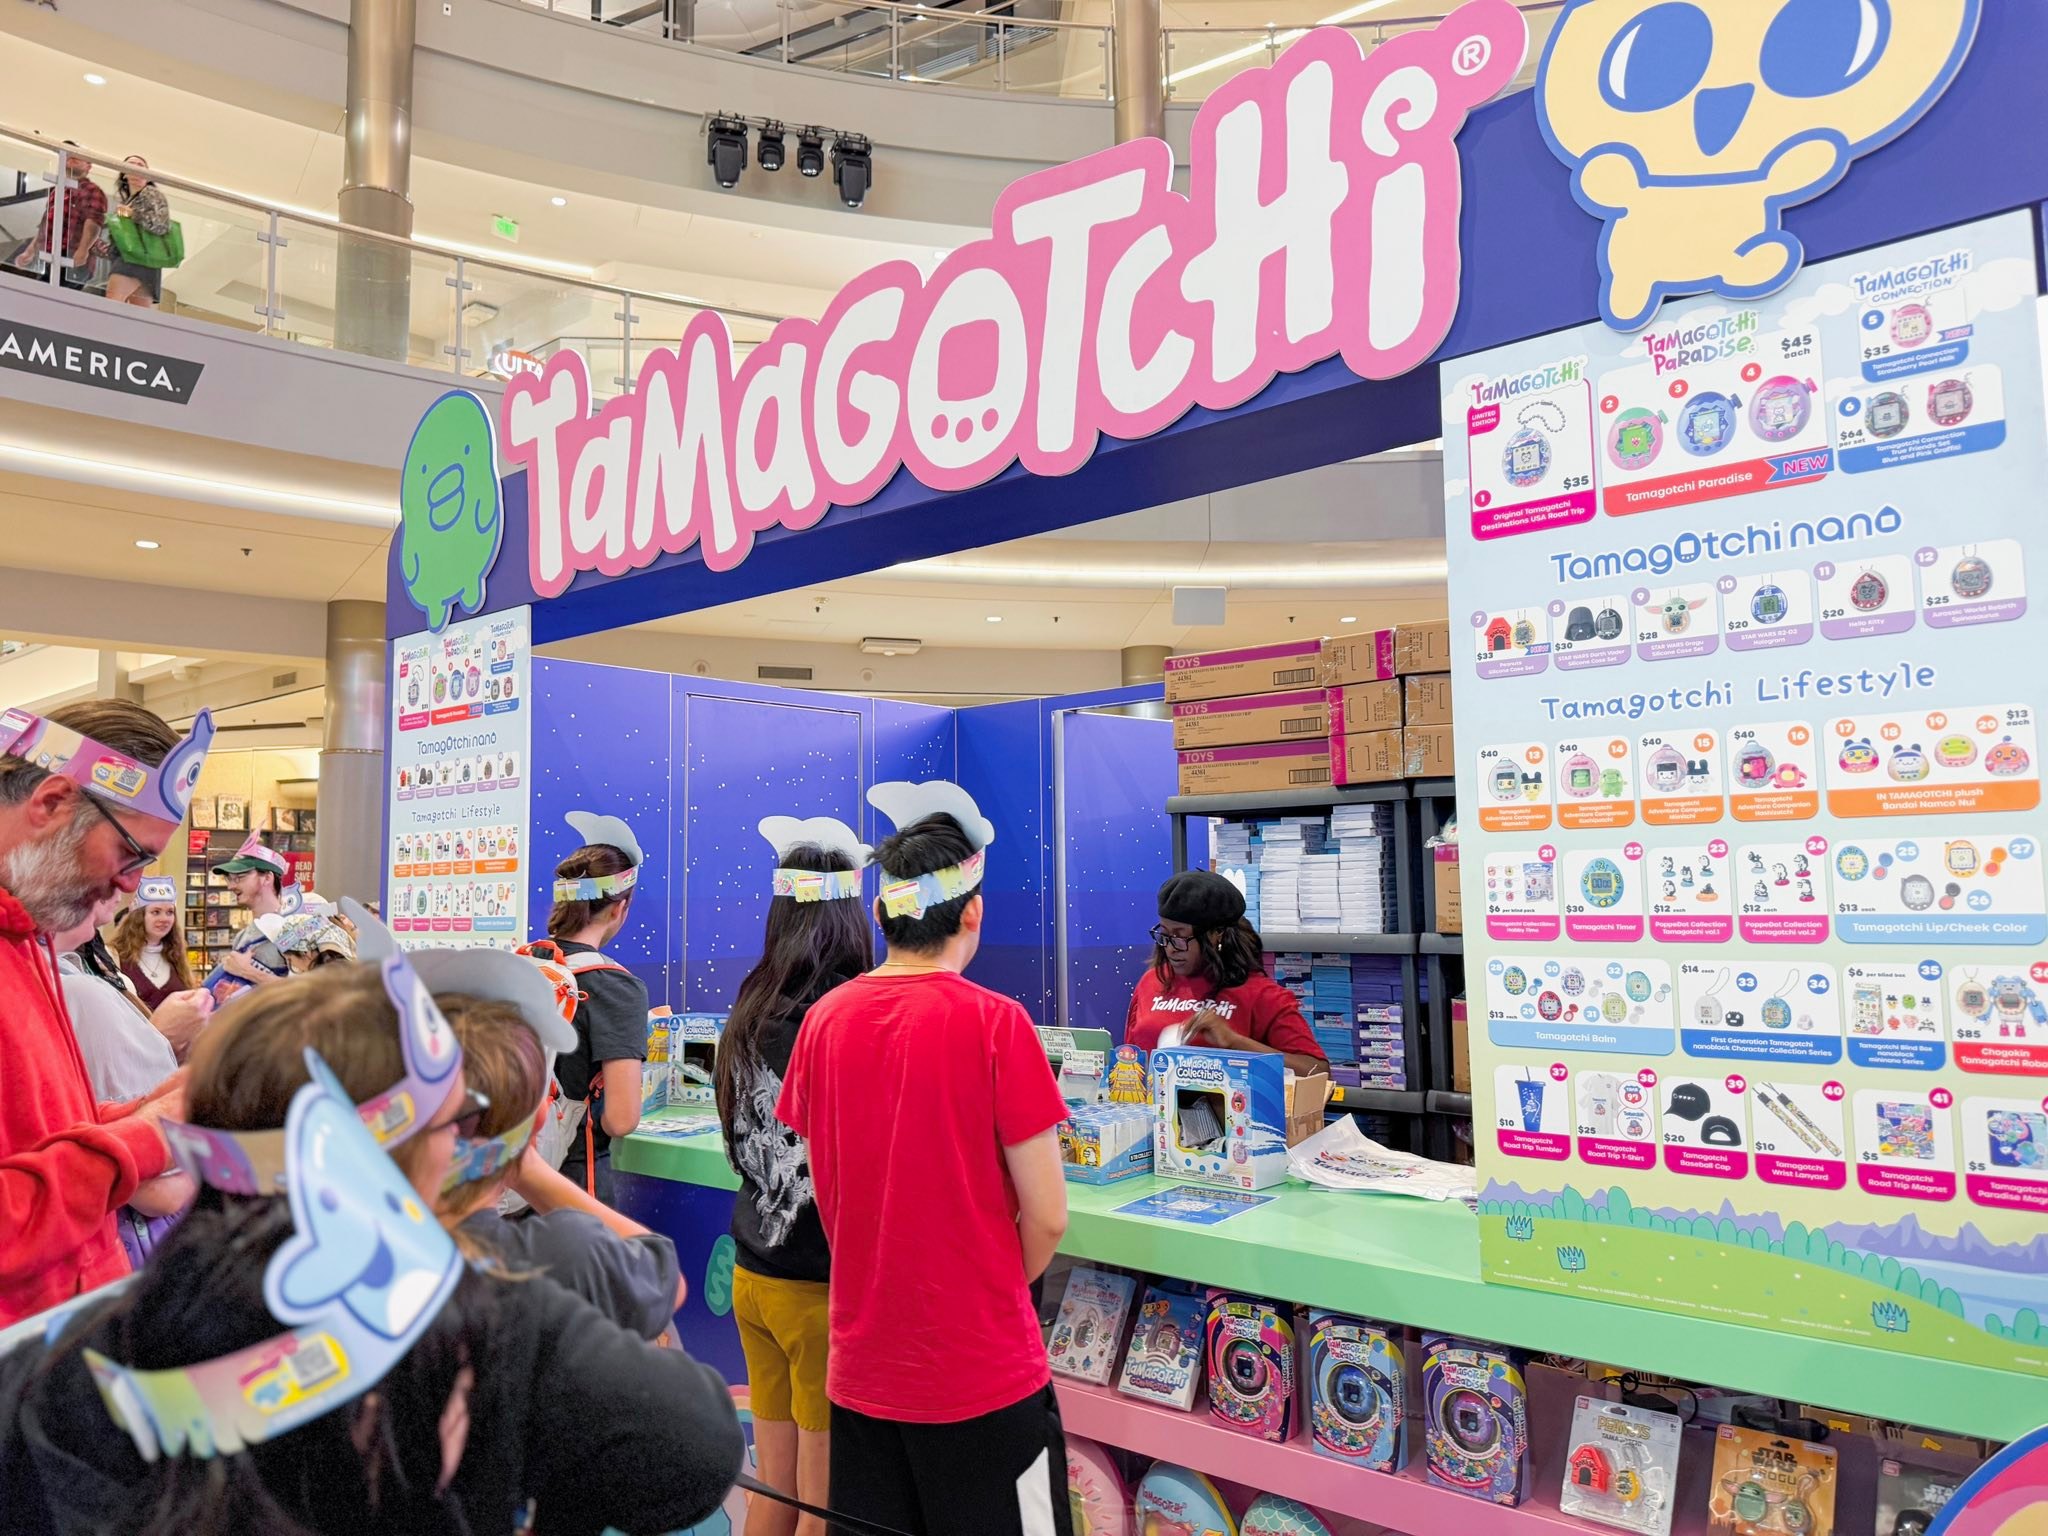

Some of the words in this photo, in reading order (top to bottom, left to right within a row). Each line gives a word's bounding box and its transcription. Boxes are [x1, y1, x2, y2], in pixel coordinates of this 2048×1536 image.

[1872, 276, 1952, 303] CONNECTION
[1868, 316, 1877, 325] 5
[1781, 334, 1812, 352] $45
[1784, 347, 1810, 359] each
[1864, 345, 1890, 359] $35
[1876, 362, 1918, 376] Strawberry
[1918, 358, 1938, 368] Pearl
[1939, 354, 1955, 364] Milk
[1747, 368, 1755, 376] 4
[1674, 385, 1682, 393] 3
[1606, 400, 1613, 408] 2
[1845, 402, 1854, 410] 6
[1472, 410, 1496, 420] LIMITED
[1472, 418, 1496, 427] EDITION
[1840, 429, 1863, 441] $64
[1783, 455, 1828, 475] NEW
[1563, 475, 1589, 489] $35
[1626, 482, 1695, 502] Tamagotchi
[1698, 471, 1752, 490] Paradise
[1480, 494, 1485, 502] 1
[1493, 510, 1523, 520] Original
[1525, 501, 1571, 516] Tamagotchi
[1550, 521, 1782, 582] Tamagotchi
[1790, 505, 1902, 547] nano
[1918, 552, 1934, 563] 12
[1819, 567, 1830, 576] 11
[1720, 579, 1734, 589] 10
[1636, 591, 1644, 600] 9
[1926, 596, 1949, 606] $25
[1552, 604, 1561, 612] 8
[1822, 609, 1844, 619] $20
[1475, 615, 1482, 624] 7
[1728, 620, 1748, 630] $20
[1639, 632, 1658, 641] $28
[1555, 642, 1573, 651] $30
[1477, 652, 1494, 661] $33
[1171, 657, 1200, 669] TOYS
[1541, 680, 1732, 719] Tamagotchi
[1758, 662, 1935, 701] Lifestyle
[1179, 704, 1208, 715] TOYS
[2006, 710, 2028, 720] $13
[1928, 716, 1945, 727] 19
[1978, 719, 1996, 730] 20
[1839, 723, 1852, 733] 17
[1883, 727, 1898, 736] 18
[472, 732, 496, 747] nano
[1734, 731, 1755, 740] $40
[1792, 732, 1805, 740] 16
[1642, 738, 1661, 747] $40
[1698, 738, 1710, 747] 15
[1559, 744, 1577, 753] $40
[1611, 745, 1624, 753] 14
[1185, 752, 1214, 762] TOYS
[1481, 750, 1498, 758] $40
[1528, 751, 1540, 759] 13
[1889, 790, 1952, 800] TAMAGOTCHI
[1955, 789, 1984, 798] plush
[1883, 801, 1917, 810] Bandai
[1919, 800, 1955, 808] Namco
[1958, 798, 1976, 806] Nui
[412, 810, 457, 823] Tamagotchi
[462, 803, 501, 818] Lifestyle
[1711, 843, 1726, 853] 23
[1808, 841, 1825, 850] 24
[2012, 843, 2031, 854] 27
[1541, 850, 1553, 858] 21
[1626, 847, 1641, 855] 22
[1898, 846, 1916, 856] 25
[296, 861, 312, 870] READ
[1969, 896, 1989, 905] 26
[1566, 905, 1584, 913] $30
[1853, 923, 1923, 933] Tamagotchi
[1926, 923, 1989, 933] Lip/Cheek
[1992, 923, 2028, 932] Color
[1546, 965, 1558, 973] 30
[1920, 966, 1940, 976] 35
[1738, 978, 1755, 987] 33
[1809, 979, 1827, 989] 34
[1522, 1007, 1534, 1015] 29
[1535, 1032, 1590, 1042] Tamagotchi
[1592, 1034, 1616, 1044] Balm
[1957, 1029, 1981, 1039] $85
[1711, 1036, 1727, 1044] First
[1728, 1037, 1768, 1045] Generation
[1769, 1039, 1813, 1047] Tamagotchi
[1693, 1043, 1730, 1051] nanoblock
[1731, 1045, 1768, 1053] Character
[1769, 1047, 1807, 1055] Collection
[1808, 1049, 1832, 1057] Series
[1877, 1050, 1914, 1058] nanoblock
[1981, 1047, 2030, 1058] Chogokin
[1177, 1068, 1223, 1080] Collectibles
[1552, 1068, 1565, 1077] 37
[1639, 1074, 1655, 1083] 38
[1728, 1080, 1744, 1088] 39
[1824, 1087, 1842, 1096] 40
[1933, 1093, 1949, 1103] 41
[1499, 1118, 1514, 1127] $10
[1578, 1126, 1596, 1134] $25
[1514, 1135, 1553, 1145] Tamagotchi
[1664, 1134, 1685, 1143] $20
[1535, 1145, 1562, 1153] Tumbler
[1595, 1143, 1637, 1152] Tamagotchi
[1755, 1142, 1775, 1151] $10
[1607, 1152, 1620, 1160] Trip
[1622, 1154, 1645, 1162] T-Shirt
[1682, 1152, 1728, 1162] Tamagotchi
[1863, 1151, 1879, 1161] $5
[1680, 1160, 1713, 1169] Baseball
[1714, 1163, 1731, 1171] Cap
[1776, 1161, 1824, 1172] Tamagotchi
[1969, 1161, 1986, 1171] $5
[1772, 1169, 1794, 1178] Wrist
[1795, 1171, 1829, 1181] Lanyard
[1880, 1171, 1933, 1183] Tamagotchi
[1868, 1179, 1891, 1188] Road
[1893, 1182, 1910, 1190] Trip
[1911, 1184, 1948, 1194] Magnet
[1990, 1182, 2048, 1194] Tamagotchi
